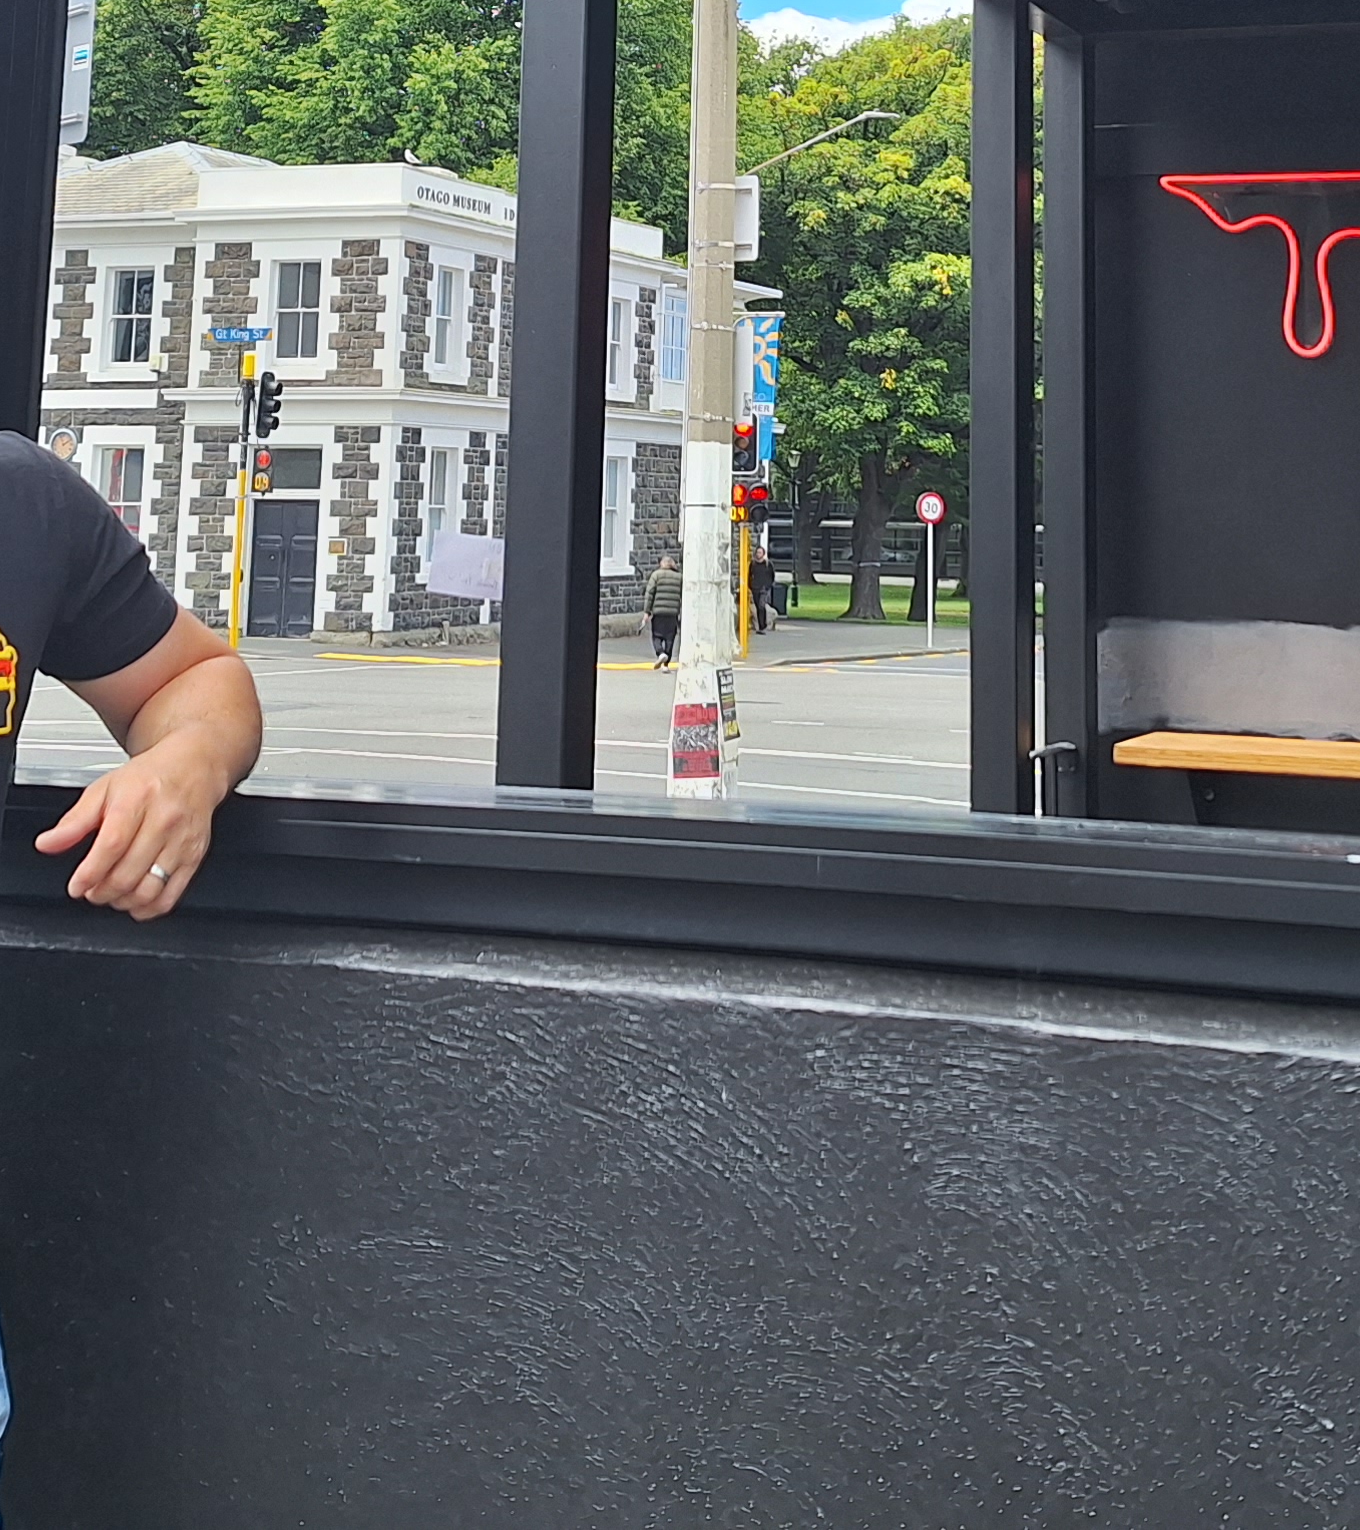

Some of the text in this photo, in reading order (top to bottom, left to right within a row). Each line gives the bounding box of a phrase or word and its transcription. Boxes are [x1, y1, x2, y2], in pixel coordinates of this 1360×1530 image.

[417, 186, 450, 205] OTAGO
[453, 194, 491, 215] MUSEUM
[215, 328, 264, 341] Gt King St
[924, 501, 938, 514] 30
